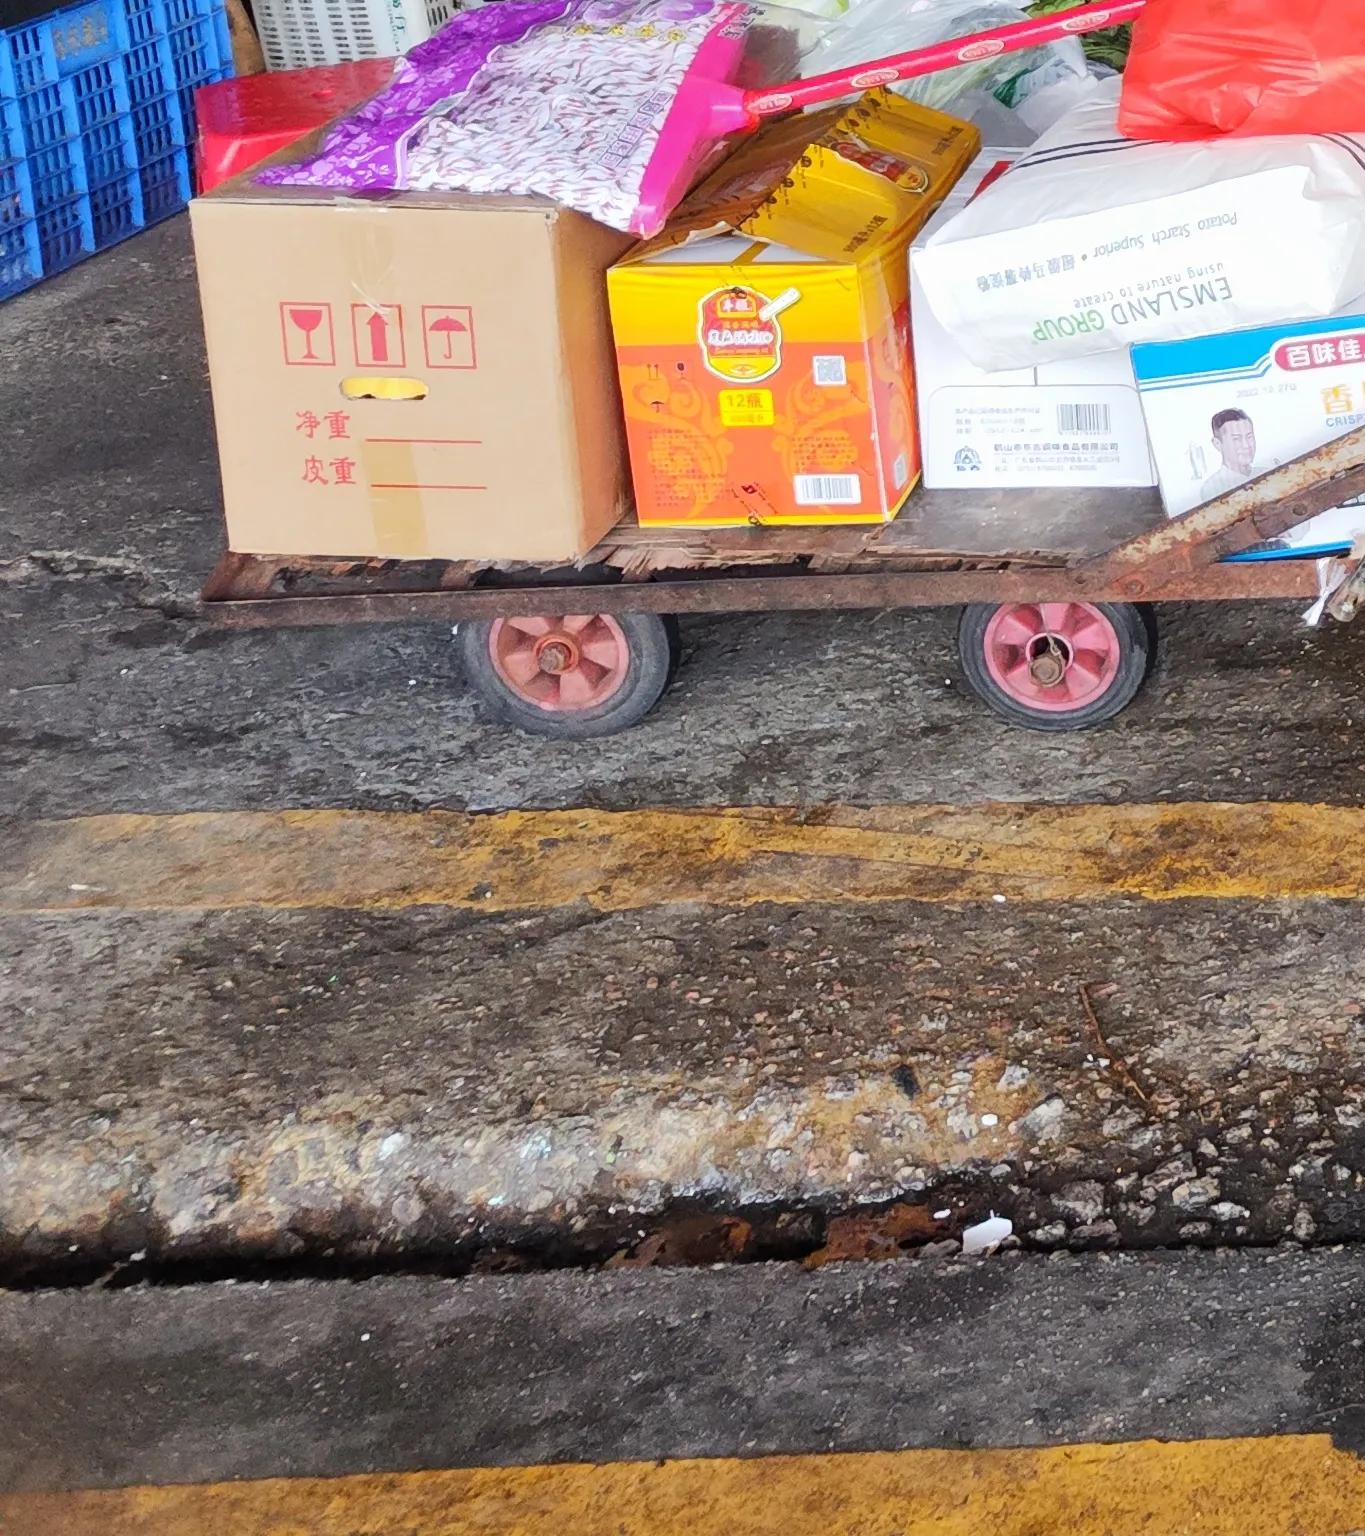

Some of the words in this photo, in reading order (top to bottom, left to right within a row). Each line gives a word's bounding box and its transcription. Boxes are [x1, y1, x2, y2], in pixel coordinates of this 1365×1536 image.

[1198, 212, 1237, 231] Potato
[1152, 223, 1191, 245] Starch
[1093, 235, 1144, 258] Superior
[1137, 271, 1182, 292] nature
[1187, 262, 1224, 279] using
[1073, 292, 1115, 309] create
[1111, 276, 1232, 325] EMSLAND
[1119, 284, 1133, 298] to
[1033, 309, 1105, 342] GROUP
[1286, 339, 1362, 368] 百味佳
[296, 410, 351, 439] 净重
[302, 455, 356, 485] 皮重
